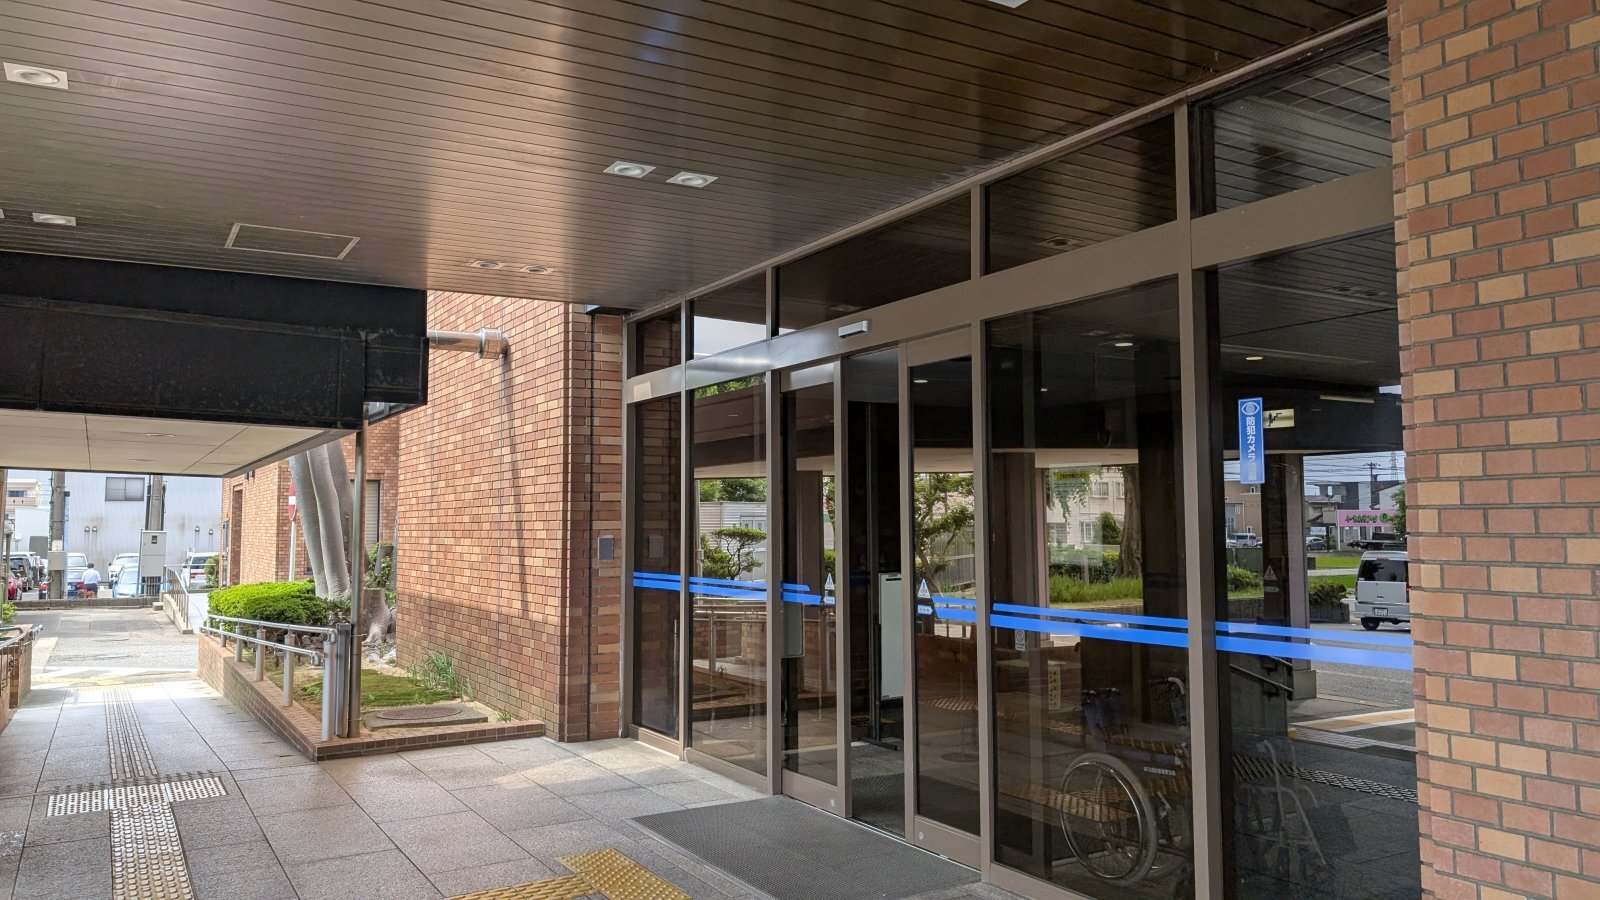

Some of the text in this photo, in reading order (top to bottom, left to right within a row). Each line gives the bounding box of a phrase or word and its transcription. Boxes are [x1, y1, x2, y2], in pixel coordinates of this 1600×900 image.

[1246, 416, 1257, 481] 防犯カメラ
